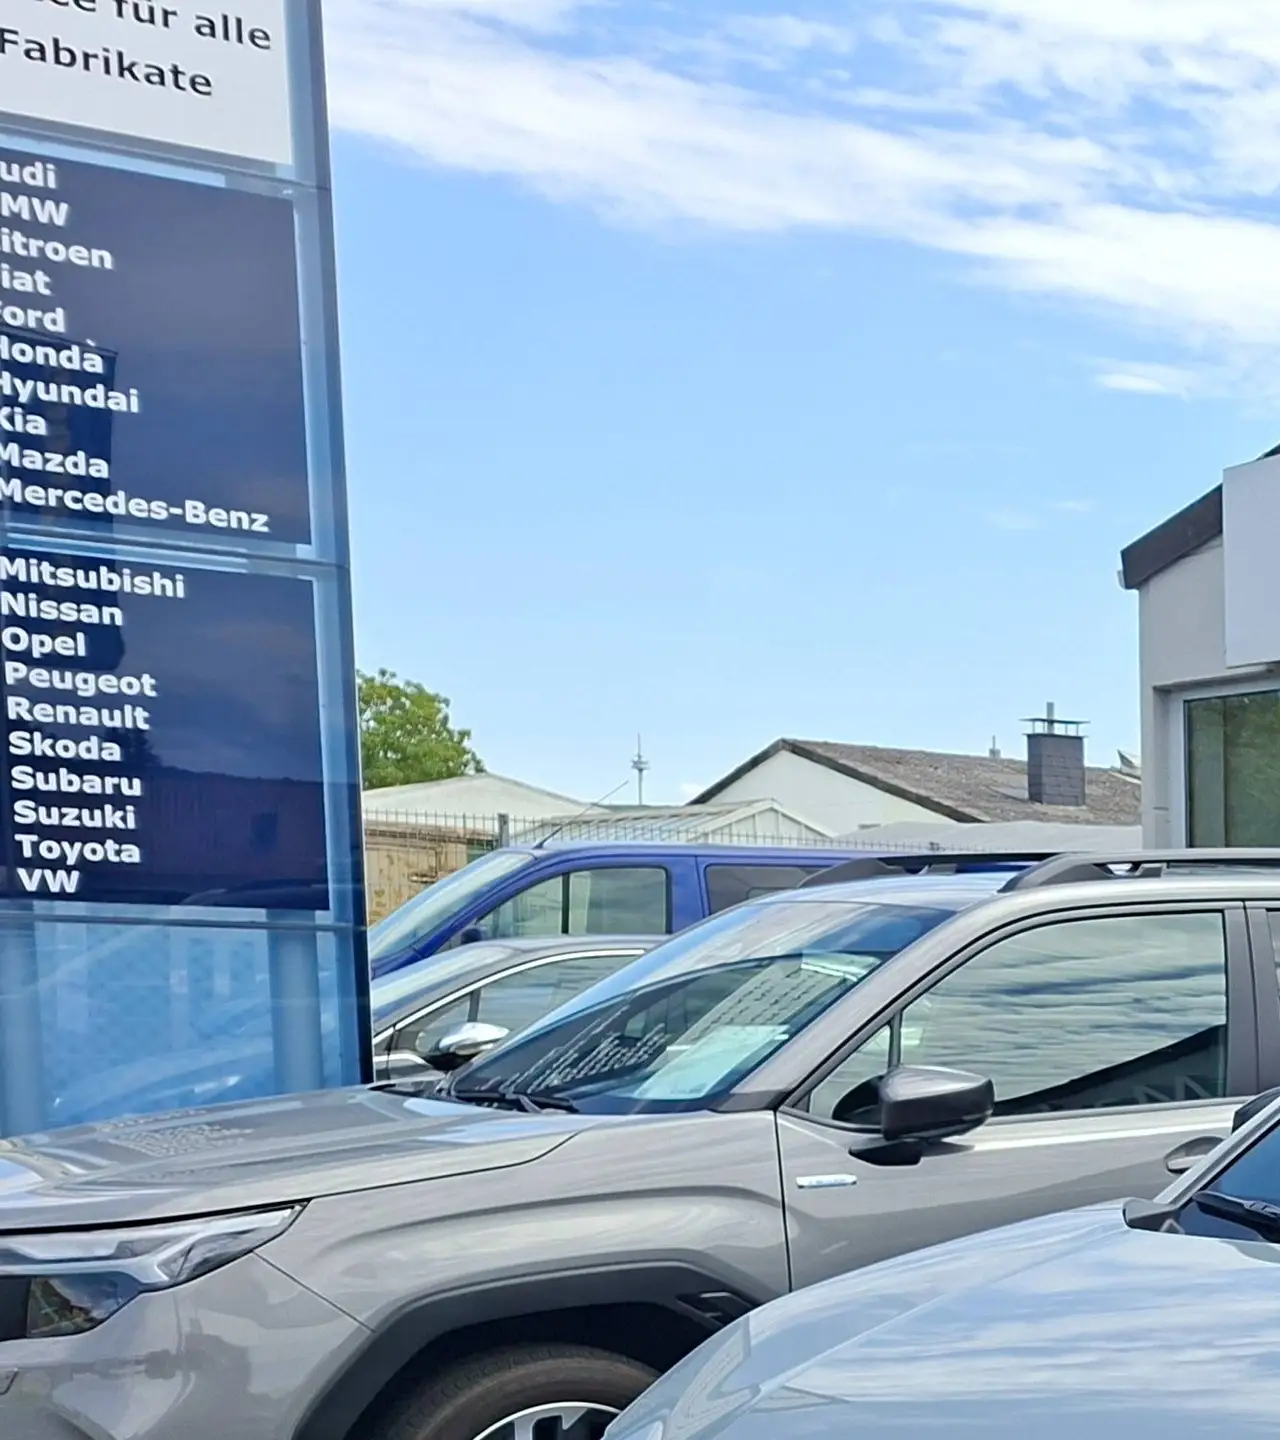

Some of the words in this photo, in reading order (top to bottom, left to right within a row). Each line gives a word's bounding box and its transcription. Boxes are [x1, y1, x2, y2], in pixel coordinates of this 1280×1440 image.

[195, 13, 272, 50] alle
[0, 27, 213, 96] Fabrikate
[0, 161, 57, 189] udi
[0, 191, 69, 227] MW
[0, 227, 114, 270] itroen
[0, 263, 52, 296] iat
[0, 303, 66, 333] ord
[0, 442, 110, 478] Mazda
[0, 477, 270, 532] Mercedes-Benz
[0, 555, 185, 598] Mitsubishi
[0, 591, 124, 626] Nissan
[1, 626, 86, 658] Opel
[4, 661, 158, 698] Peugeot
[7, 697, 151, 731] Renault
[8, 731, 122, 762] Skoda
[11, 766, 142, 797] Subaru
[13, 800, 136, 830] Suzuki
[14, 834, 141, 865] Toyota
[16, 867, 80, 893] VW
